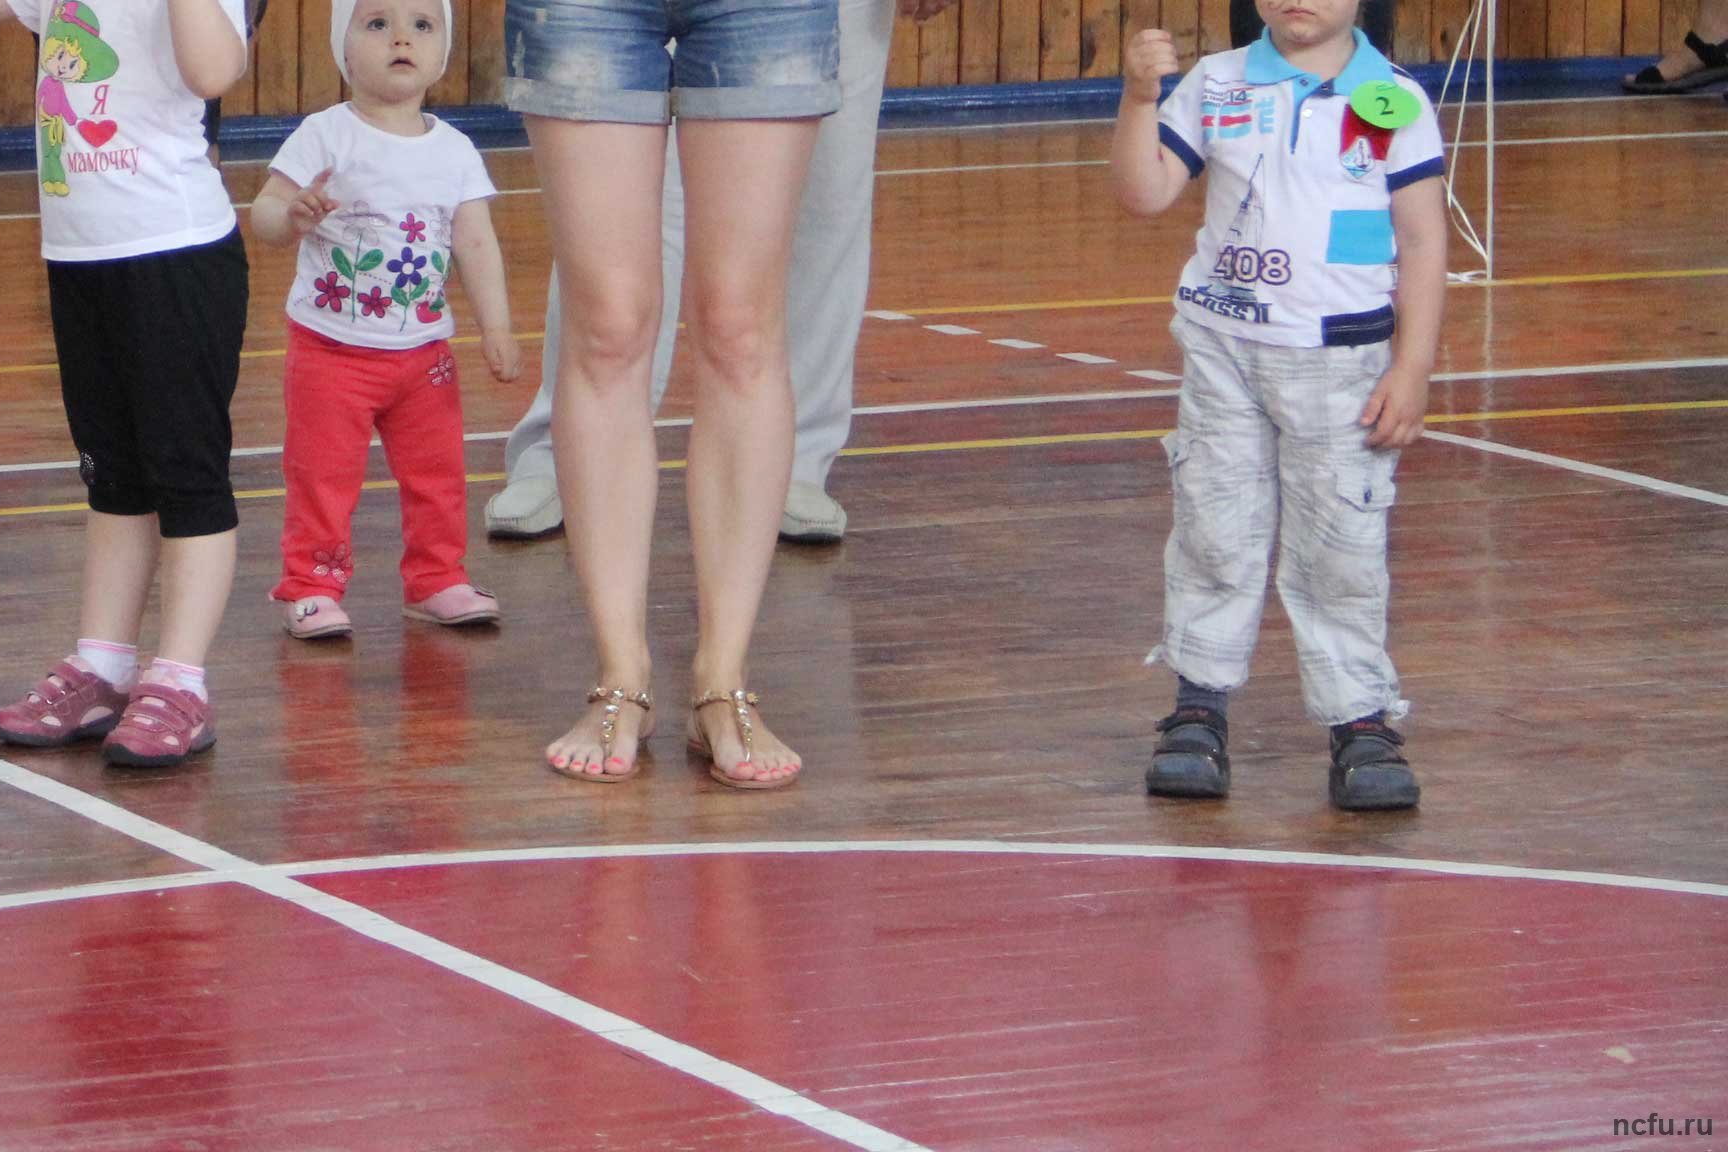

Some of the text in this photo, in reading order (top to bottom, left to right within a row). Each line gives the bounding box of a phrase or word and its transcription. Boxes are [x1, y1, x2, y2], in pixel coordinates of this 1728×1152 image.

[89, 83, 110, 116] Я
[1375, 96, 1394, 116] 2
[67, 146, 143, 175] мамочку
[1214, 245, 1291, 285] 408
